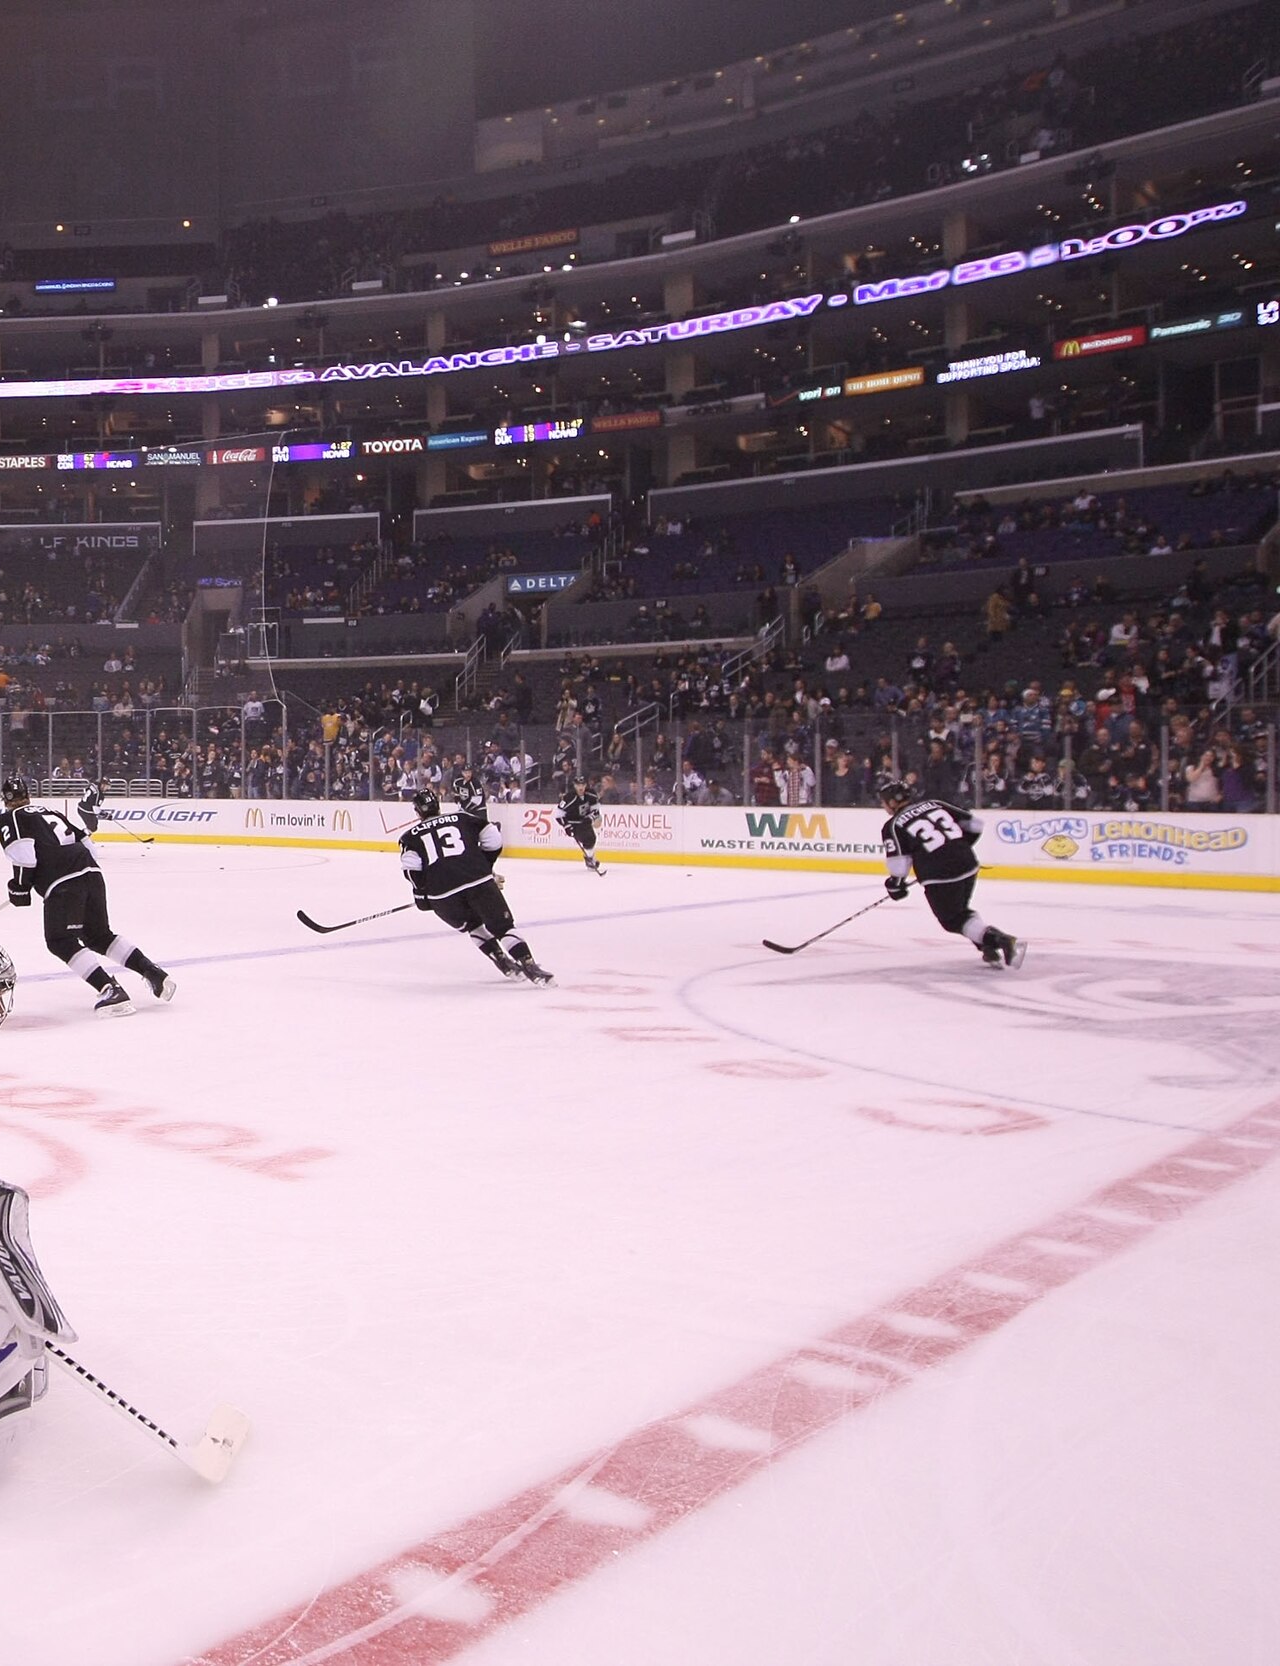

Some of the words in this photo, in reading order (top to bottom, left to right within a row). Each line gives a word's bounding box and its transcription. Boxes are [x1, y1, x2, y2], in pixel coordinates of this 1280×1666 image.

[489, 238, 533, 256] WELLS
[535, 231, 577, 247] FARGO
[952, 250, 1028, 285] 26
[1151, 319, 1212, 338] Panasonic
[321, 342, 558, 382] AVALANCHE
[587, 294, 823, 351] SATURDAY
[1081, 334, 1133, 350] McDonald's
[949, 357, 983, 373] THANK
[984, 354, 1003, 368] YOU
[1005, 350, 1026, 362] FOR
[936, 364, 999, 384] SUPPORTING
[555, 418, 584, 430] 11:47
[594, 418, 630, 429] WELLS
[330, 441, 352, 450] 4:27
[363, 439, 423, 454] TOYOTA
[428, 435, 460, 447] American
[460, 433, 488, 444] Express
[495, 435, 512, 446] DUK
[147, 453, 163, 461] SAN
[169, 452, 200, 461] MANUEL
[77, 535, 139, 548] KINGS
[157, 810, 218, 823] LIGHT
[270, 813, 286, 826] i'm
[288, 814, 316, 827] lovin'
[317, 815, 326, 827] it
[410, 814, 459, 836] CLIFFORD
[522, 809, 553, 836] 25
[604, 814, 672, 829] MANUEL
[1, 825, 11, 842] 2
[42, 814, 76, 846] 2
[746, 813, 831, 839] WM
[908, 808, 964, 853] 33
[997, 817, 1089, 844] Chewy
[604, 831, 632, 840] BINGO
[640, 832, 672, 841] CASINO
[421, 825, 466, 866] 13
[701, 838, 755, 850] WASTE
[760, 841, 886, 854] MANAGEMENT
[1090, 847, 1105, 861] &
[1108, 844, 1189, 865] FRIENDS
